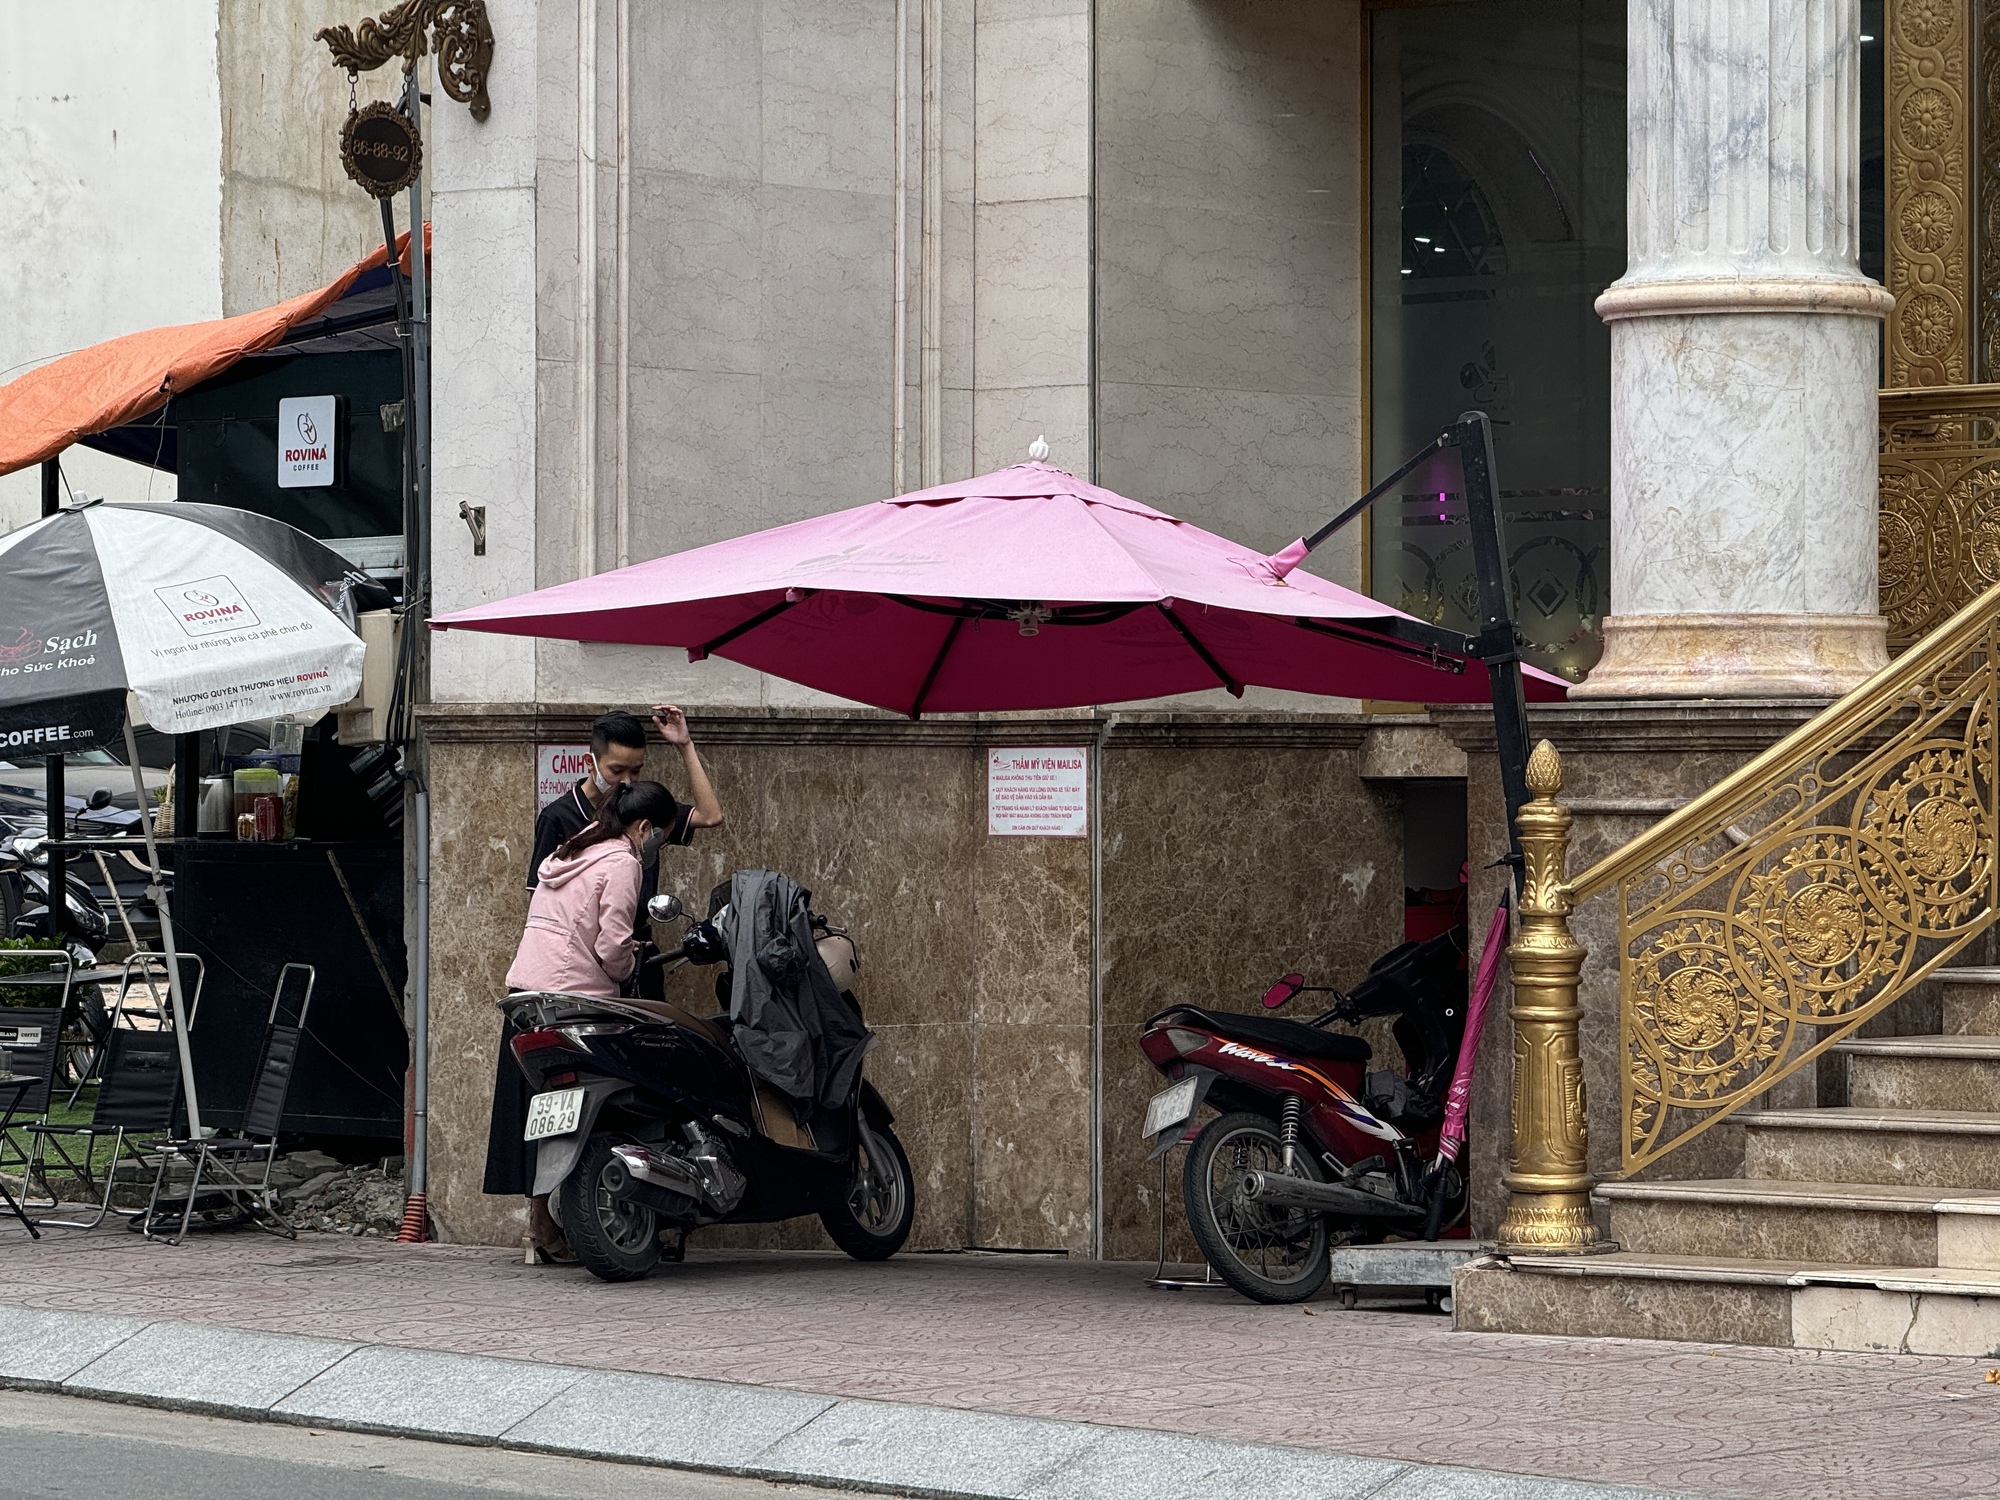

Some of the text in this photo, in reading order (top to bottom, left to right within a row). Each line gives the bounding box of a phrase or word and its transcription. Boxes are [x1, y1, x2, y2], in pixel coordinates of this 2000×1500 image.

[353, 139, 409, 162] 86-88-92
[285, 447, 327, 462] ROVINA
[293, 463, 319, 471] COFFEE
[183, 604, 244, 622] ROVINA
[202, 616, 235, 626] COFFEE
[44, 629, 98, 655] Sạch
[150, 649, 164, 658] Vị
[164, 645, 188, 657] ngon
[200, 636, 231, 650] những
[247, 631, 259, 641] cà
[261, 627, 279, 640] phê
[0, 654, 96, 677] ho Sức Khoẻ
[172, 691, 209, 706] NHƯỢNG
[239, 679, 275, 693] THƯƠNG
[276, 675, 295, 687] HIỆU
[296, 670, 329, 683] ROVINA
[175, 684, 332, 720] Hotline: 0903 147 175 www.rovina.vn
[552, 749, 585, 774] CẢNH
[1012, 755, 1082, 772] THẨM MỸ VIỆN MAILISA
[1218, 1042, 1272, 1062] Wave
[537, 1091, 575, 1115] 59-VA
[529, 1111, 576, 1136] 086.29
